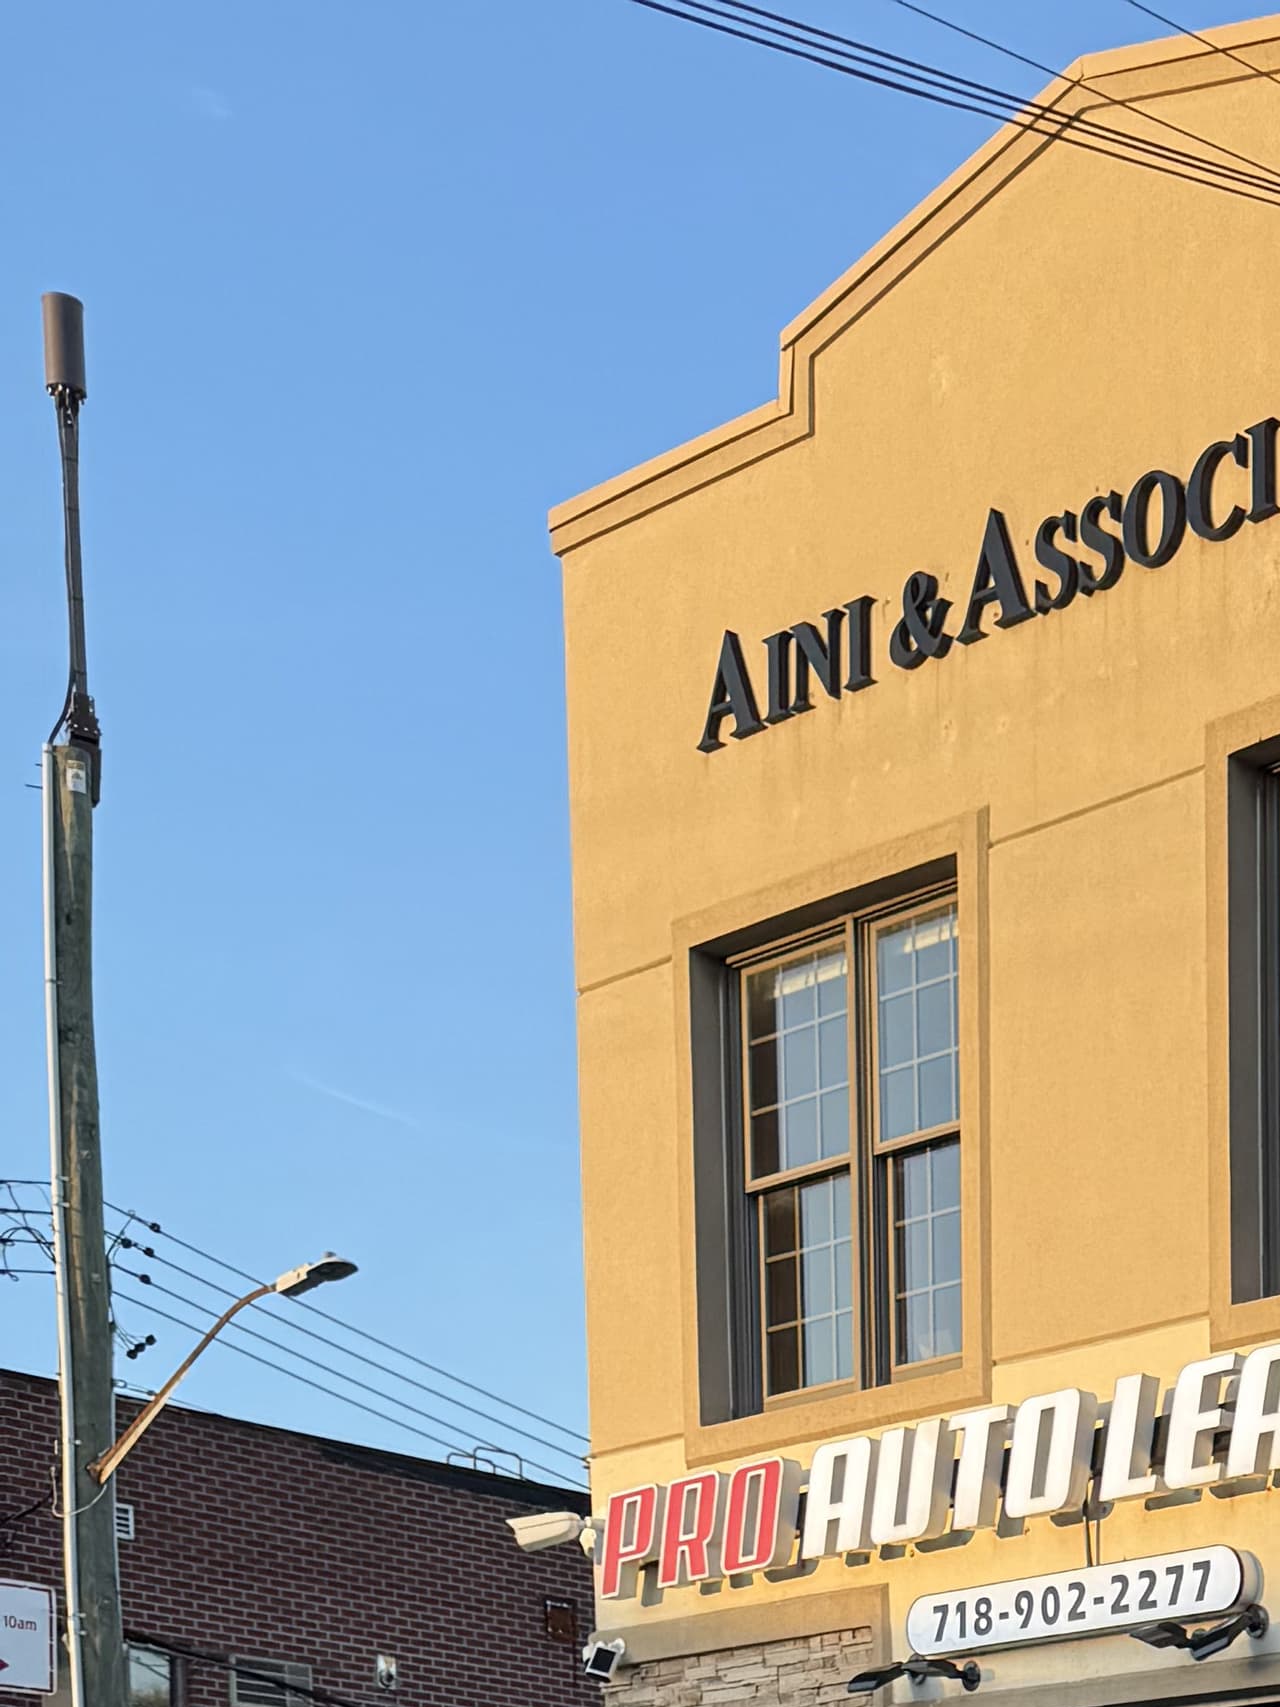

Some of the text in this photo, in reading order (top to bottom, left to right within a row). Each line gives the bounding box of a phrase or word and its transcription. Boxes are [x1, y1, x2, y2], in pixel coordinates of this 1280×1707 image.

[696, 594, 876, 754] AINI
[888, 570, 954, 671] &
[601, 1456, 792, 1597] PRO
[803, 1386, 1094, 1560] AUTO
[931, 1560, 1215, 1644] 718-902-2277
